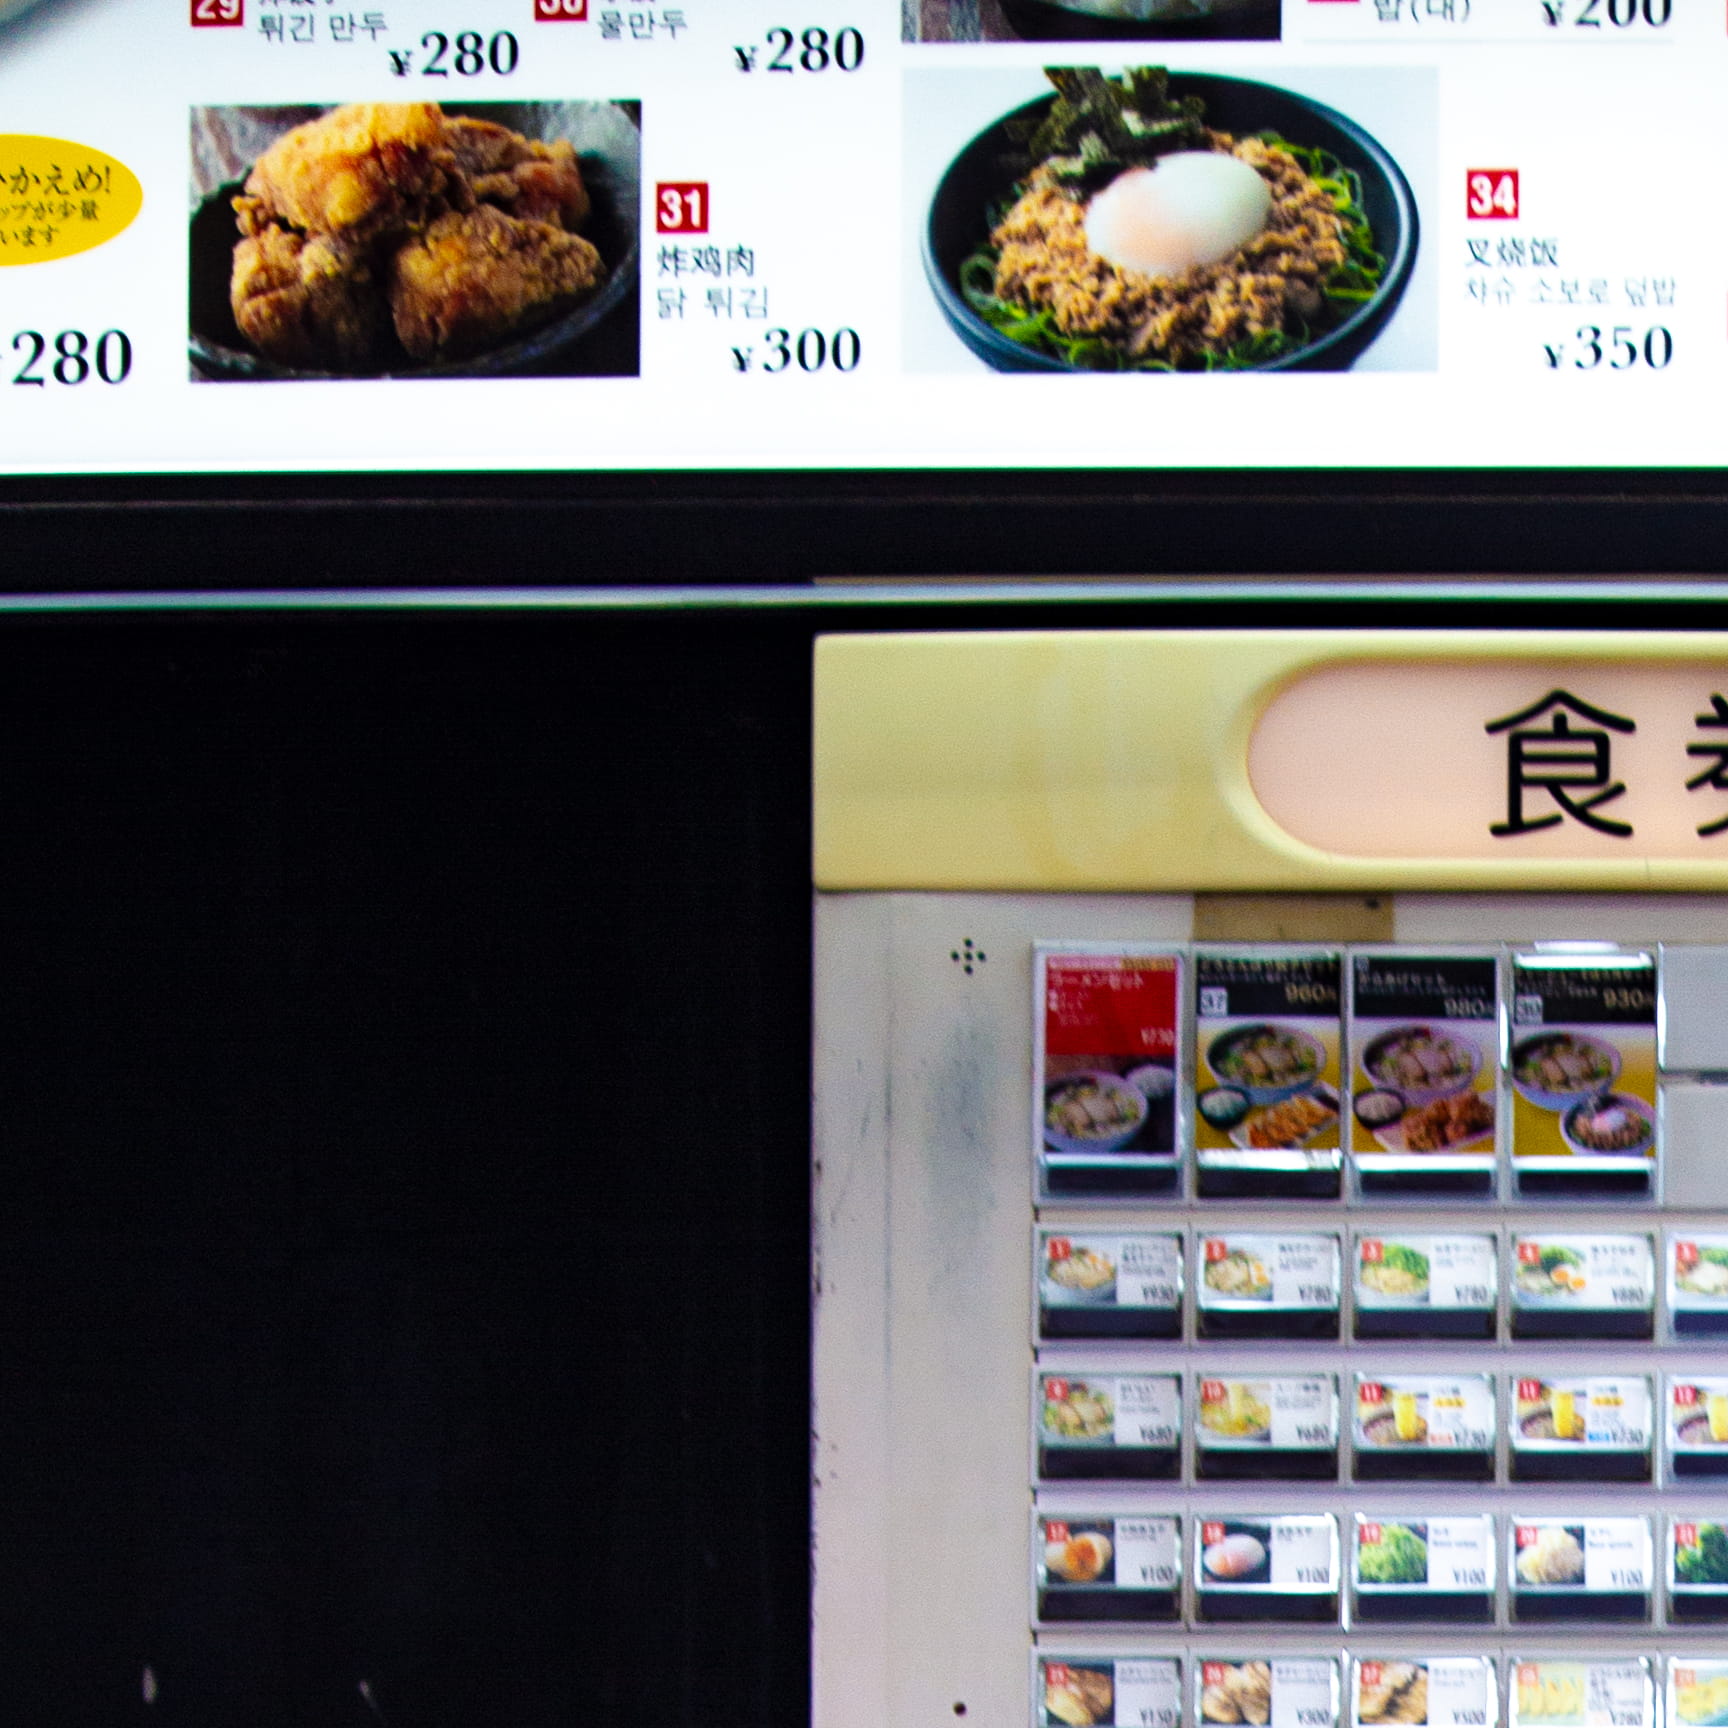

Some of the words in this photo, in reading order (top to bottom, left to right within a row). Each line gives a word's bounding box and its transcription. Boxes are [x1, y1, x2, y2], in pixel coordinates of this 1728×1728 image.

[329, 11, 390, 42] 만두
[388, 31, 520, 77] ¥280
[733, 27, 865, 73] ¥280
[659, 190, 704, 227] 31
[1471, 174, 1516, 214] 34
[657, 243, 755, 277] 炸鸡肉
[1465, 236, 1559, 268] 叉烧饭
[704, 288, 768, 319] 튀김
[730, 328, 861, 374] ¥300
[1542, 325, 1672, 370] ¥350
